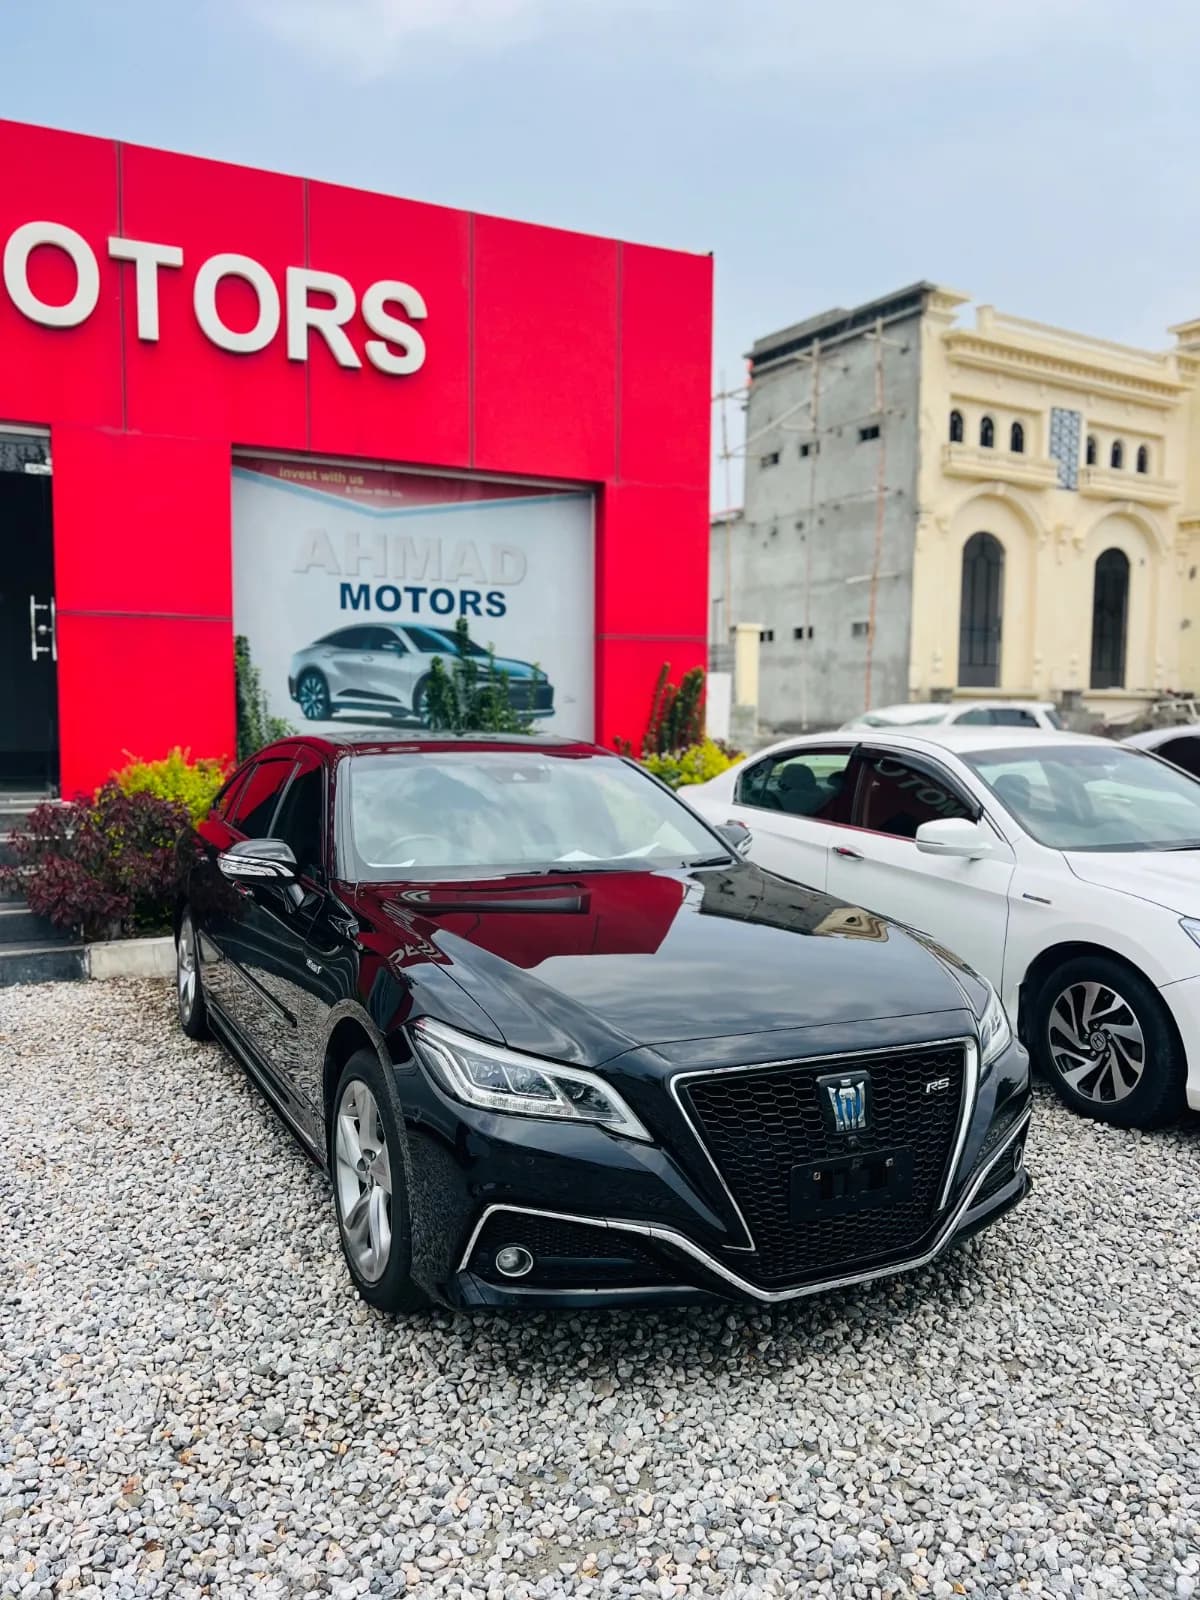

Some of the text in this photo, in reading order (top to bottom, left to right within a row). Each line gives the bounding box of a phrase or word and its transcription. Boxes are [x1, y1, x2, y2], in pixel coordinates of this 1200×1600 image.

[3, 221, 428, 375] OTORS
[320, 470, 346, 484] with
[349, 475, 364, 485] us
[293, 527, 528, 587] AHMAD
[339, 582, 507, 618] MOTORS
[925, 1077, 950, 1093] RS
